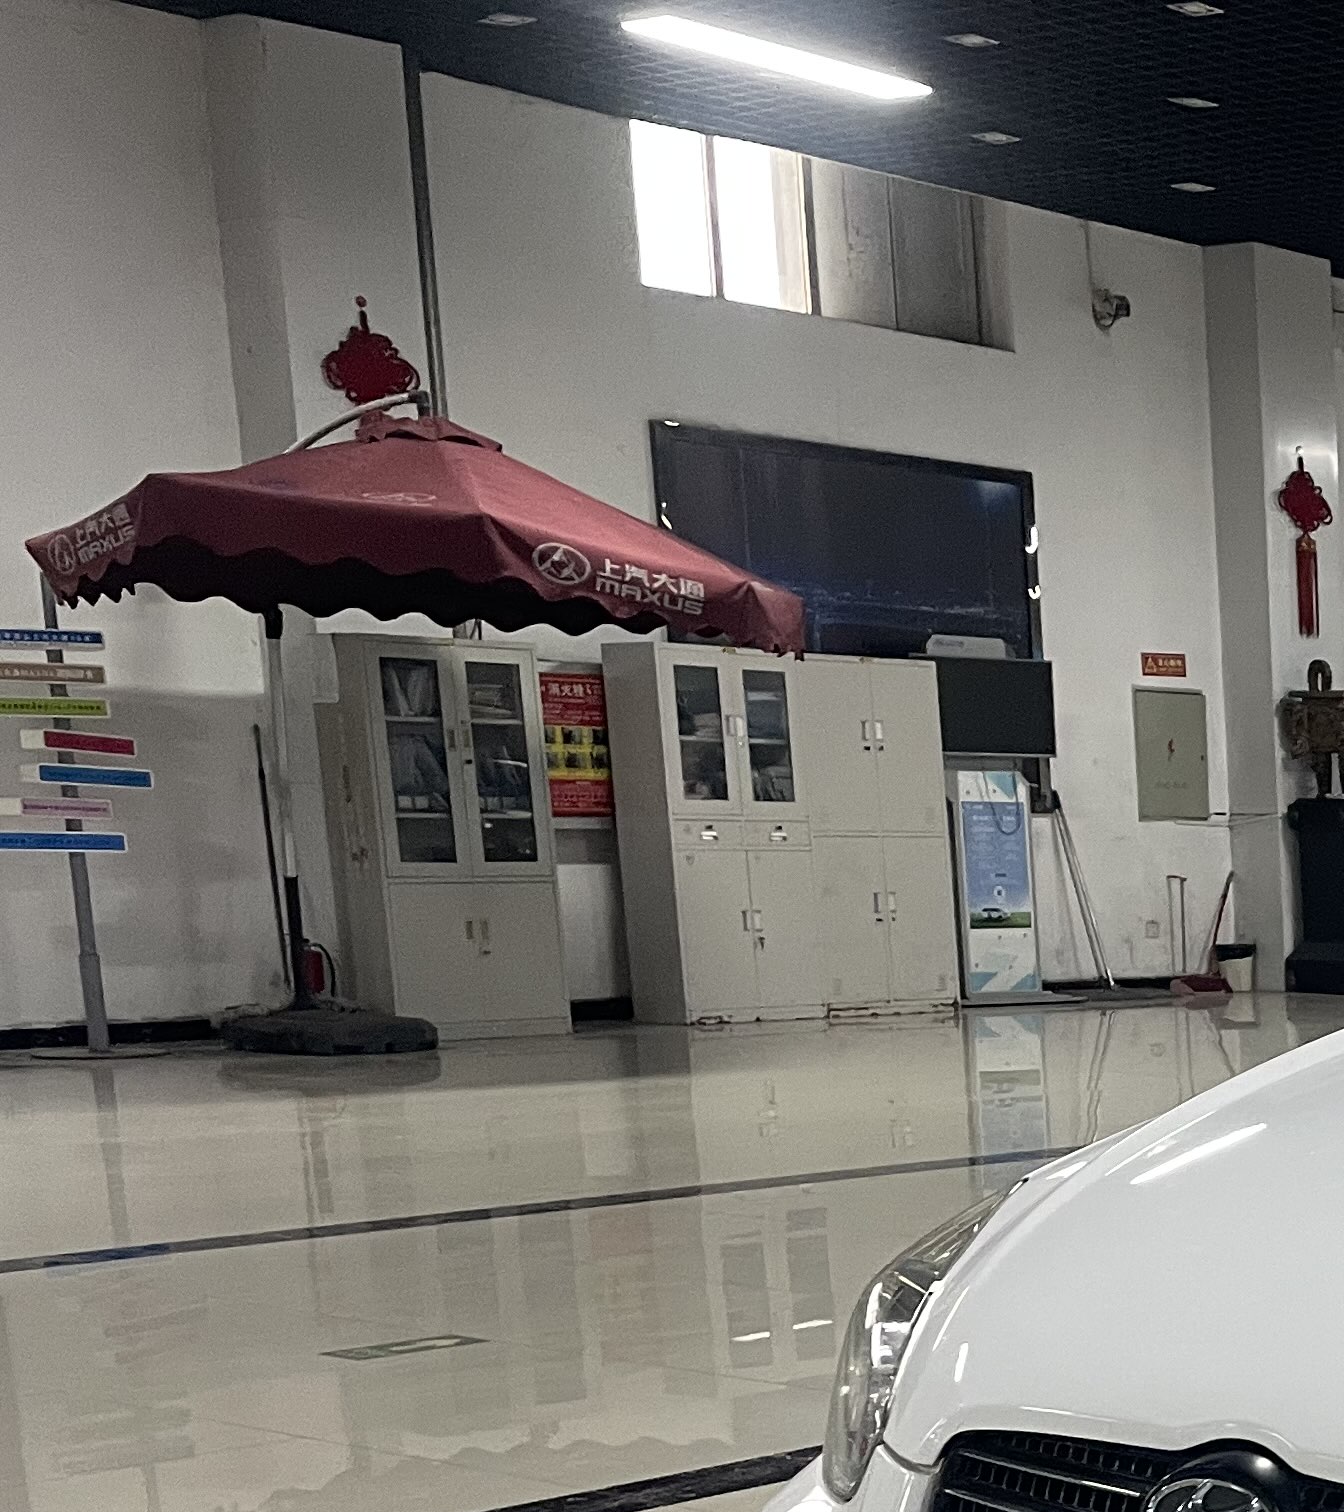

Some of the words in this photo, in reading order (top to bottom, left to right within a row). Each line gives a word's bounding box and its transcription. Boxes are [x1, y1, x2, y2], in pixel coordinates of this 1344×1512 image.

[595, 576, 704, 616] MAXUS
[596, 558, 705, 599] 上汽大通
